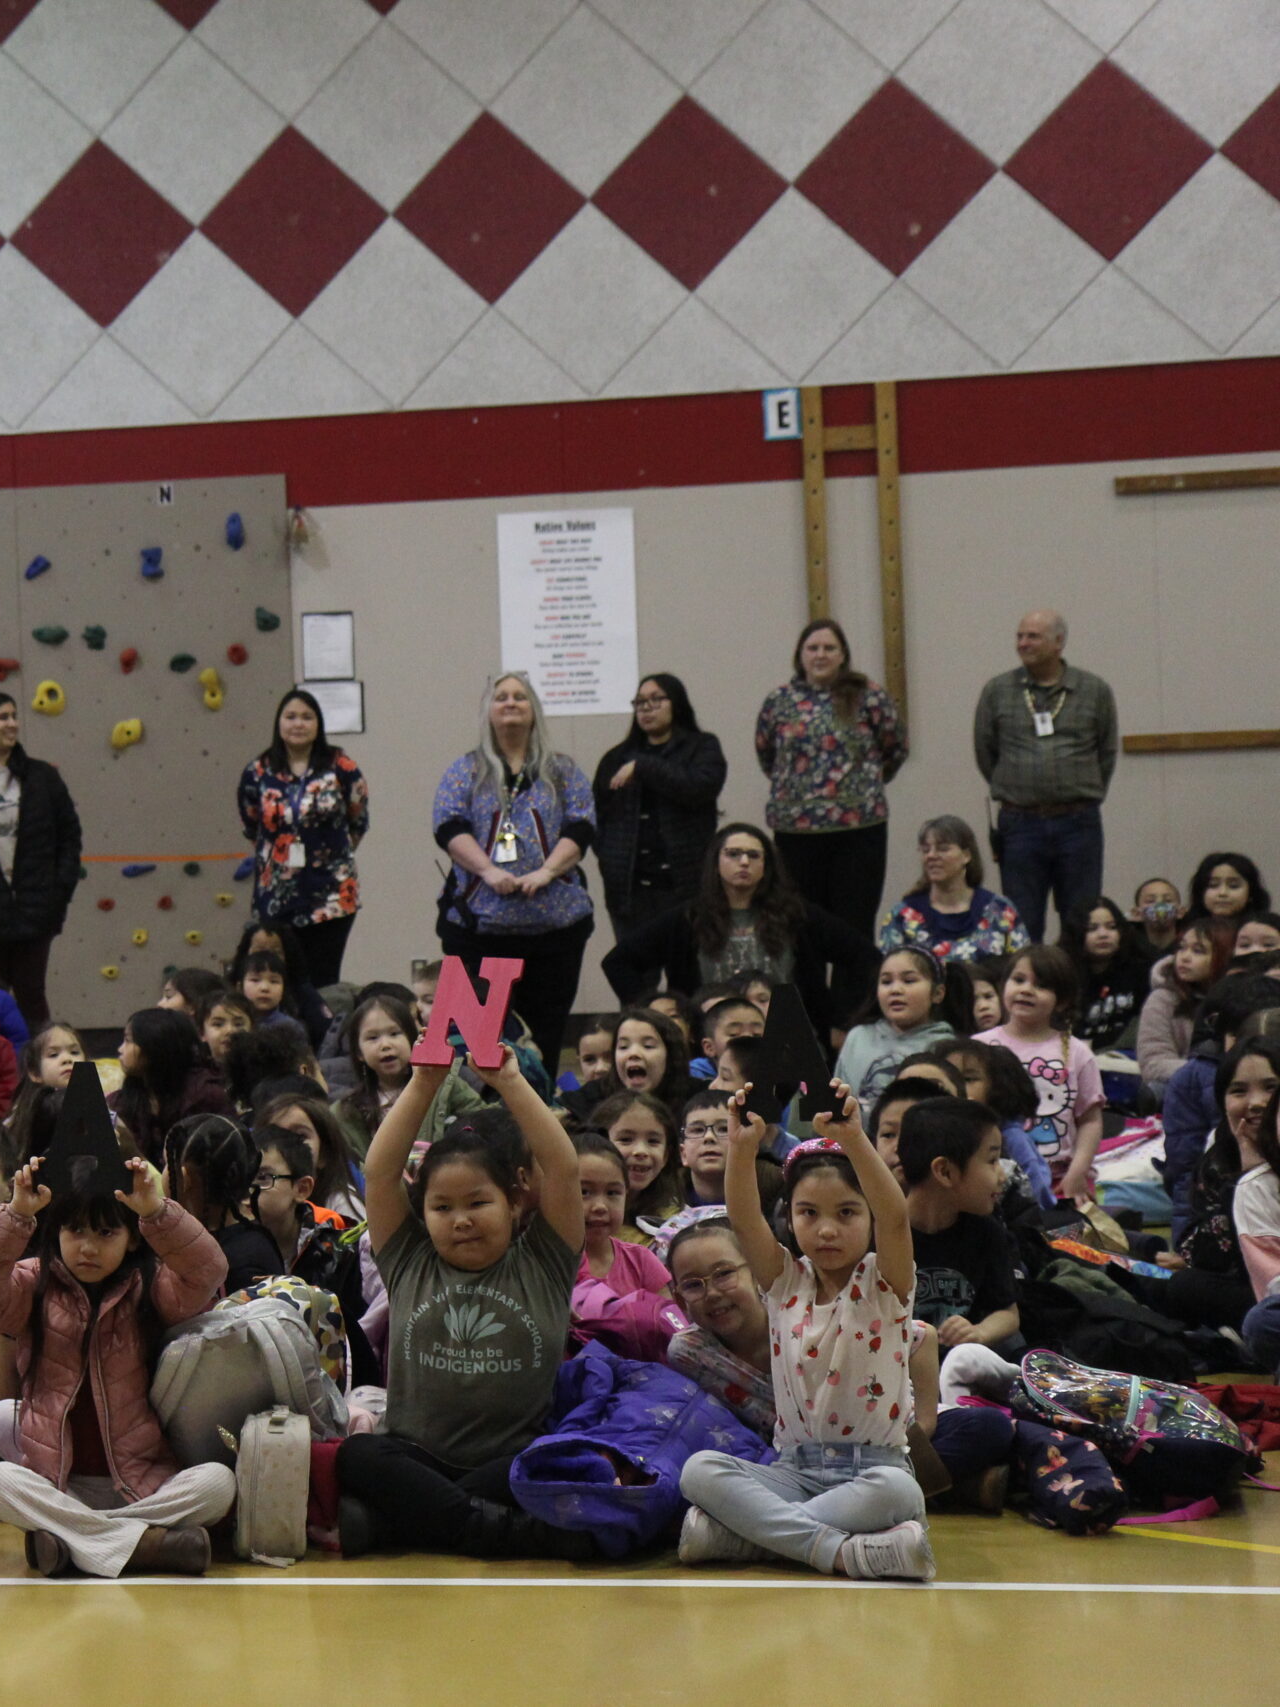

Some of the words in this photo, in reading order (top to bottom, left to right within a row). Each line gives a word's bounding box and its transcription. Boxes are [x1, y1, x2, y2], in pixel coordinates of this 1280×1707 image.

[777, 401, 790, 428] E
[160, 486, 171, 502] N
[410, 955, 524, 1069] N
[740, 983, 849, 1125] A
[32, 1062, 134, 1195] A
[403, 1302, 430, 1360] MOUNTAIN
[455, 1284, 522, 1312] ELEMENTARY
[521, 1314, 543, 1368] SCHOLAR
[433, 1342, 466, 1359] Proud
[471, 1348, 483, 1359] to
[487, 1347, 504, 1358] be
[419, 1351, 522, 1374] INDIGENOUS
